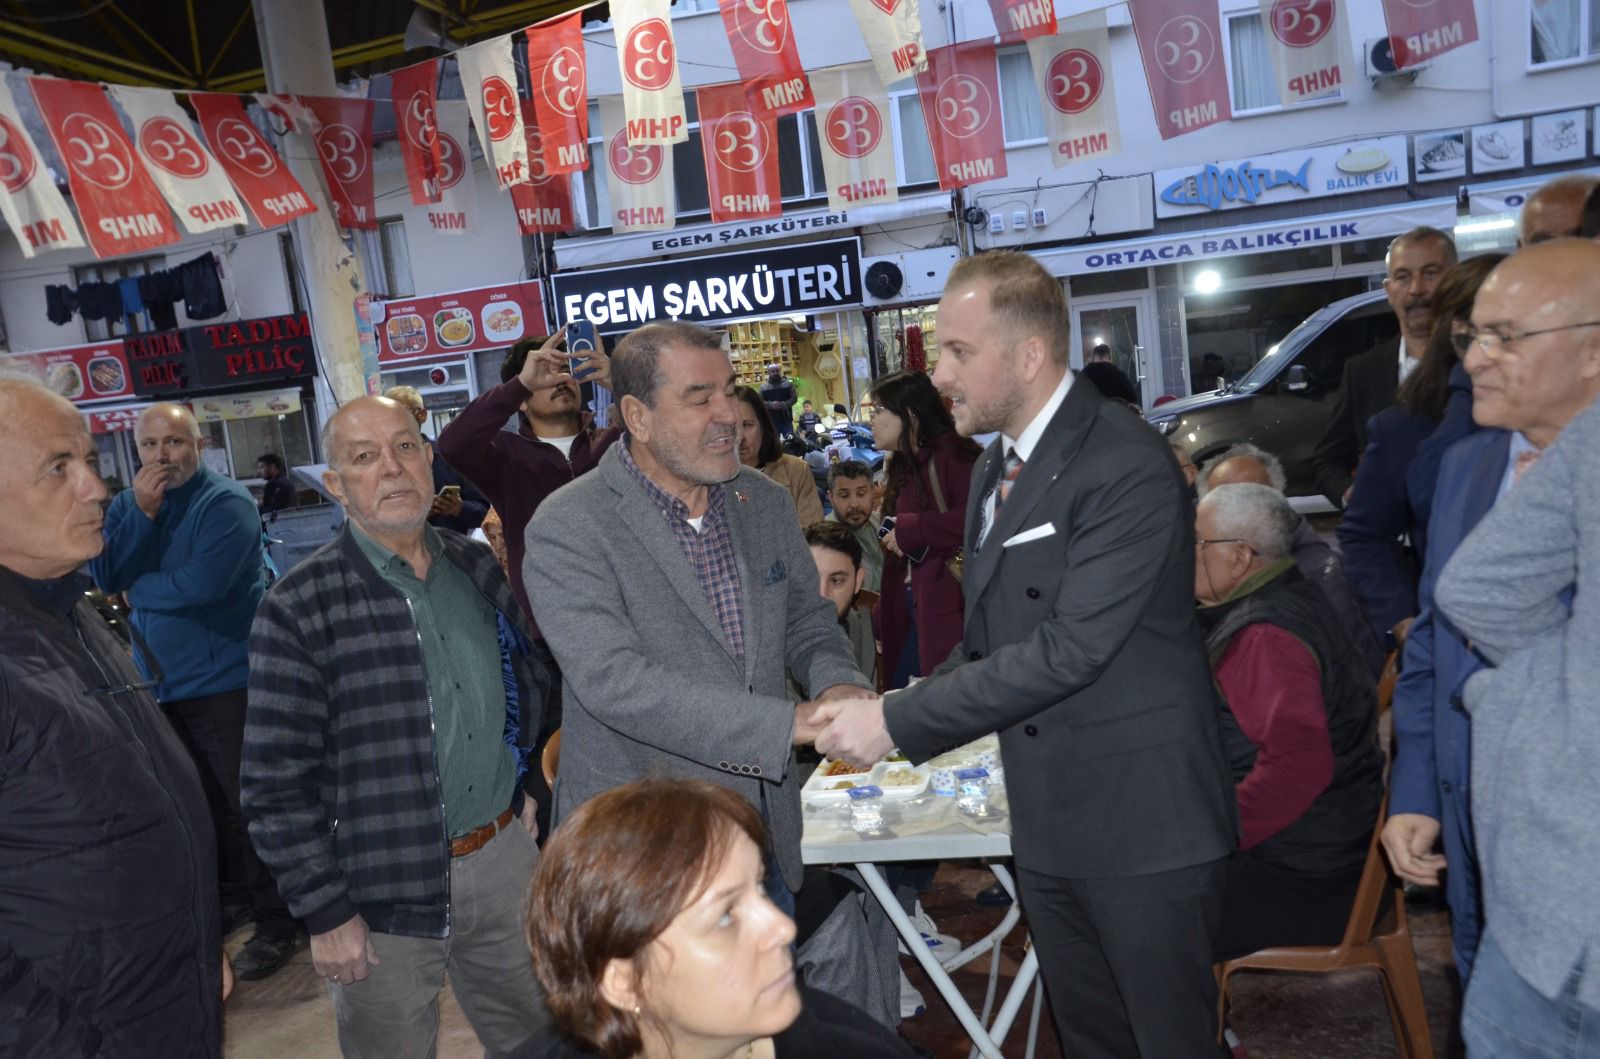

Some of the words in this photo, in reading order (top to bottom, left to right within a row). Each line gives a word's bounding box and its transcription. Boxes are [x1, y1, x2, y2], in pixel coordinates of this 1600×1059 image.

[1008, 0, 1053, 31] MHP
[762, 78, 806, 110] MHP
[628, 116, 682, 141] MHP
[1326, 173, 1369, 191] BALIK
[1374, 166, 1398, 184] EVİ
[652, 232, 713, 251] EGEM
[719, 211, 848, 242] ŞARKÜTERİ
[1085, 243, 1193, 268] ORTACA
[1202, 222, 1359, 254] BALIKÇILIK
[564, 285, 656, 325] EGEM
[663, 254, 852, 321] ŞARKÜTERİ
[127, 332, 184, 359] TADIM
[205, 313, 311, 349] TADIM
[225, 344, 305, 376] PİLİÇ
